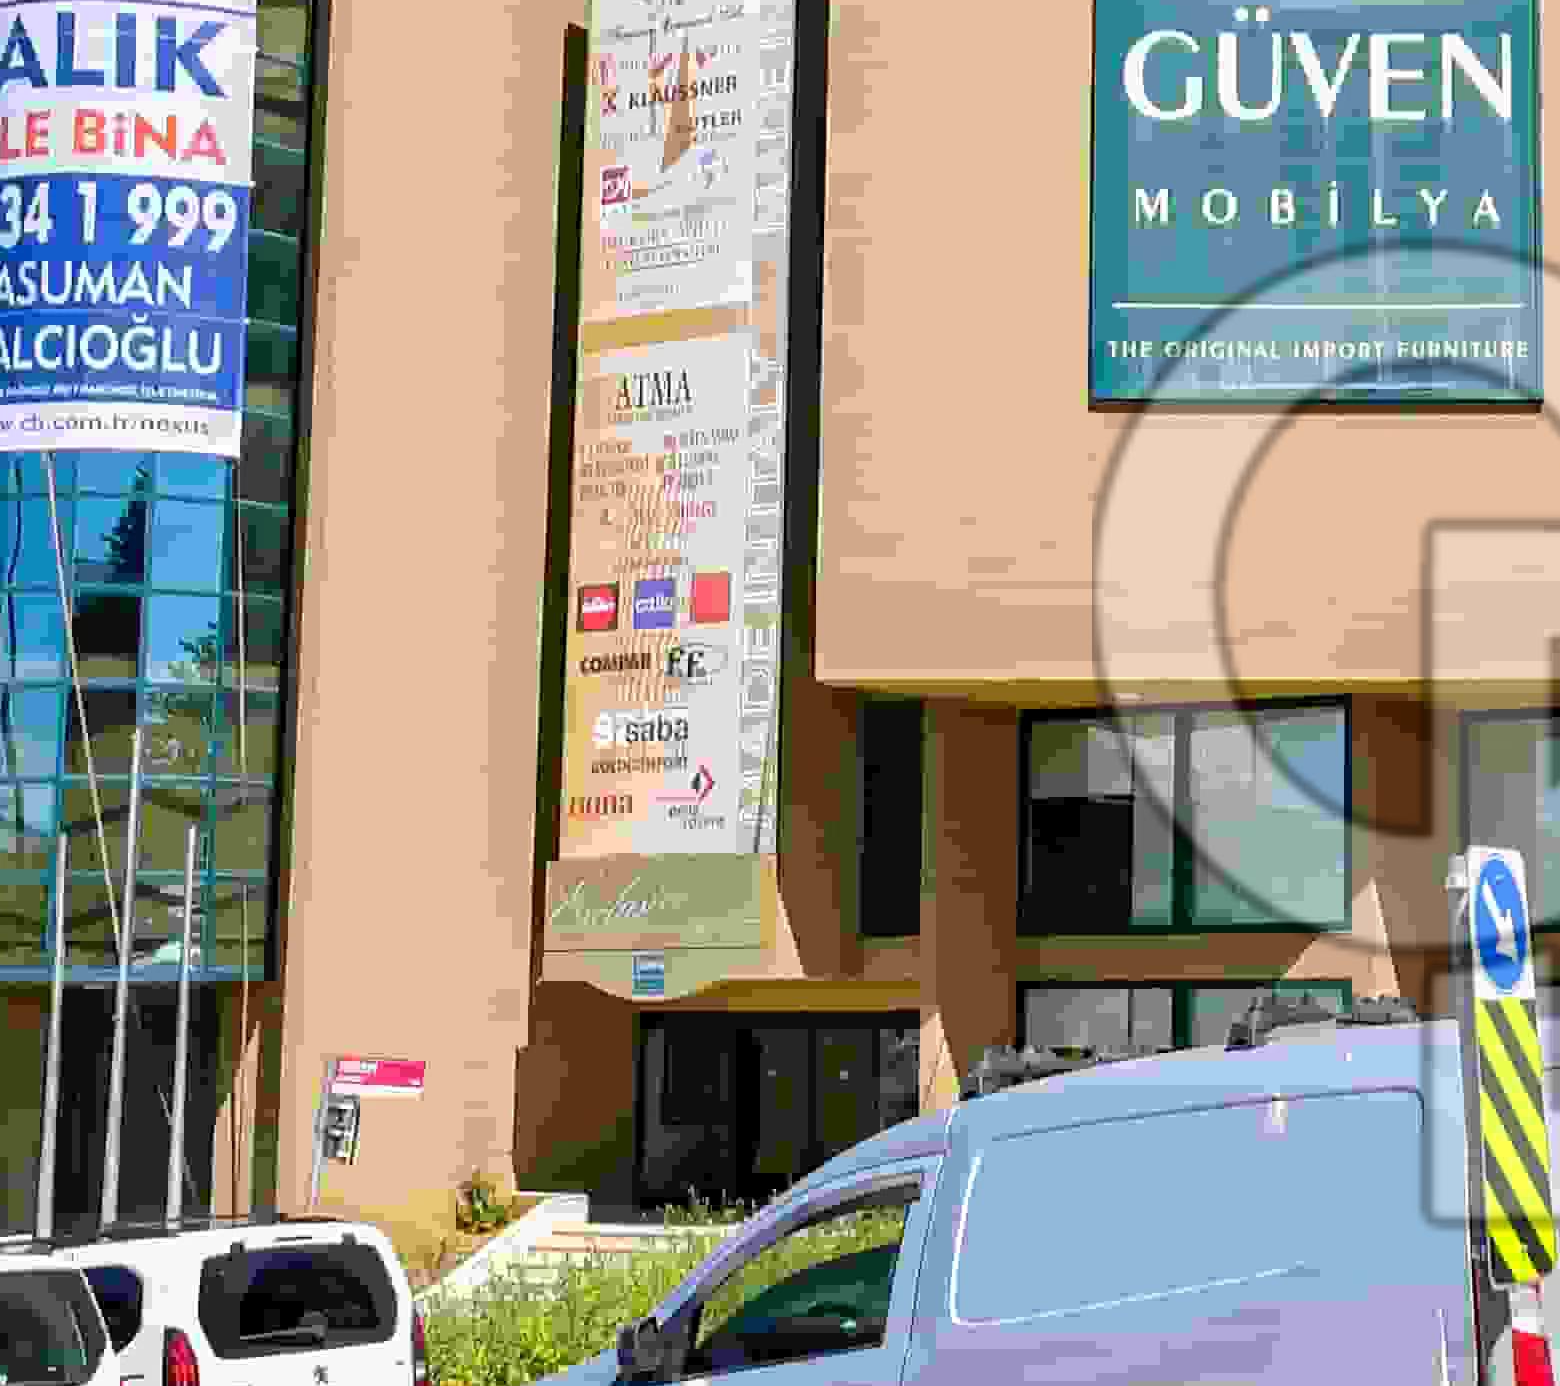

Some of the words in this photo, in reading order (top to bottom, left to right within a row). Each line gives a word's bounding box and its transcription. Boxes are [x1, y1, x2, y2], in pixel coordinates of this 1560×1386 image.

[1122, 6, 1514, 122] GÜVEN
[126, 181, 238, 254] 999
[1133, 179, 1503, 230] MOBİLYA
[1107, 339, 1154, 359] THE
[1163, 339, 1281, 360] ORIGINAL
[1292, 339, 1385, 360] IMPORT
[1397, 339, 1530, 360] FURNITURE
